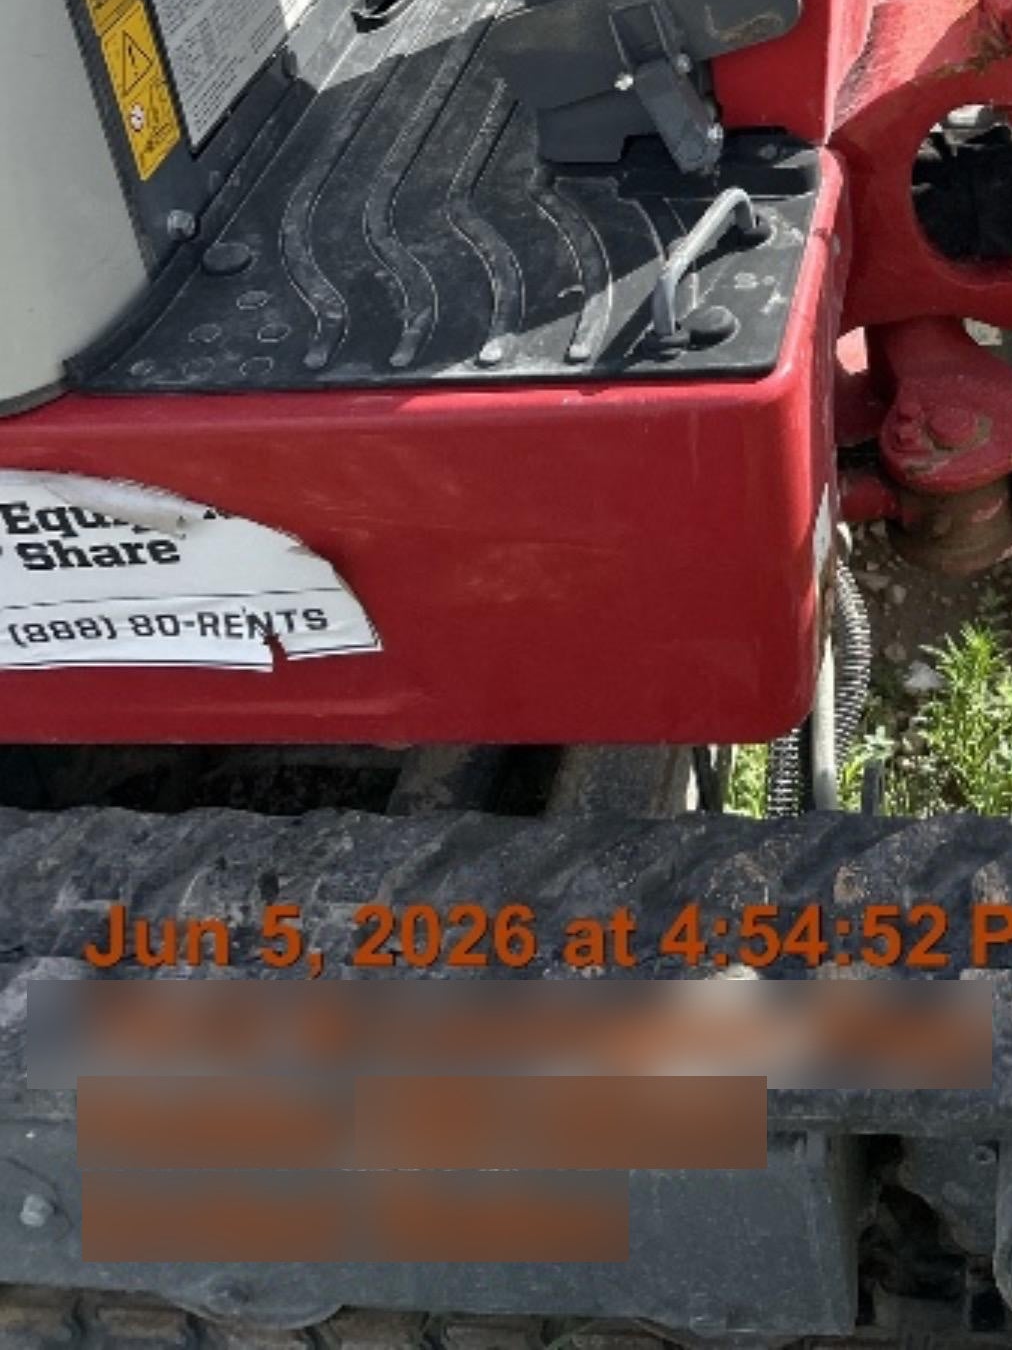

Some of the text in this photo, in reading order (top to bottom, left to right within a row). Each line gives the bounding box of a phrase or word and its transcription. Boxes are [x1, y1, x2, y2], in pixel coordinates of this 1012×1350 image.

[15, 539, 181, 570] Share
[7, 607, 329, 648] (888) 80-RENTS
